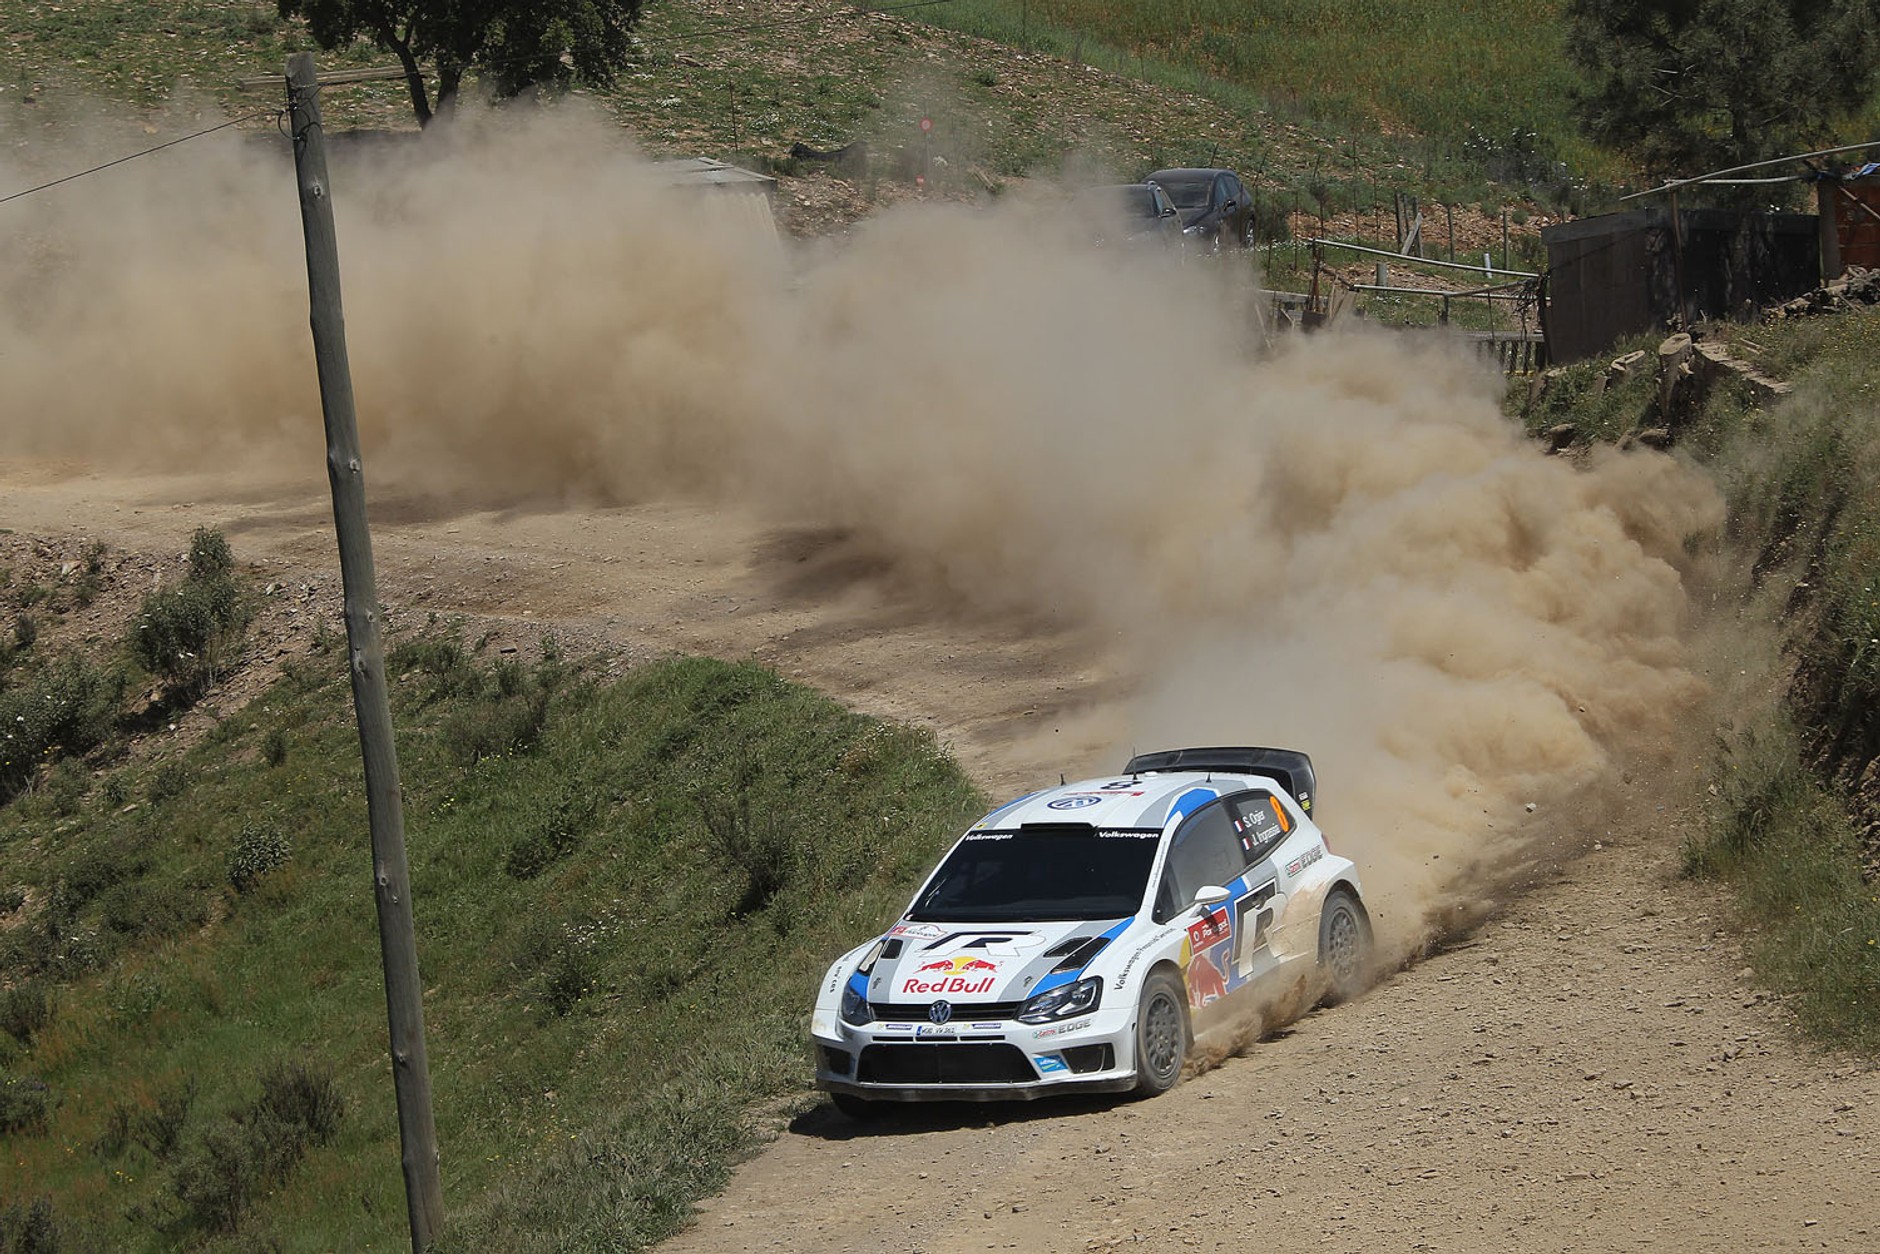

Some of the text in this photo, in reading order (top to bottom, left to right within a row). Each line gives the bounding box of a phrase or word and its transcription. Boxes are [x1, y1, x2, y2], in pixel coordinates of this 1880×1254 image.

[1242, 810, 1266, 828] S. Ogier
[1269, 795, 1290, 833] 8
[965, 833, 1013, 841] Volkswagen
[1099, 831, 1159, 839] Volkswagen
[1251, 836, 1260, 847] J.
[1113, 951, 1142, 991] Volkswagen
[903, 976, 996, 994] Red Bull
[1058, 1019, 1092, 1034] EDGE
